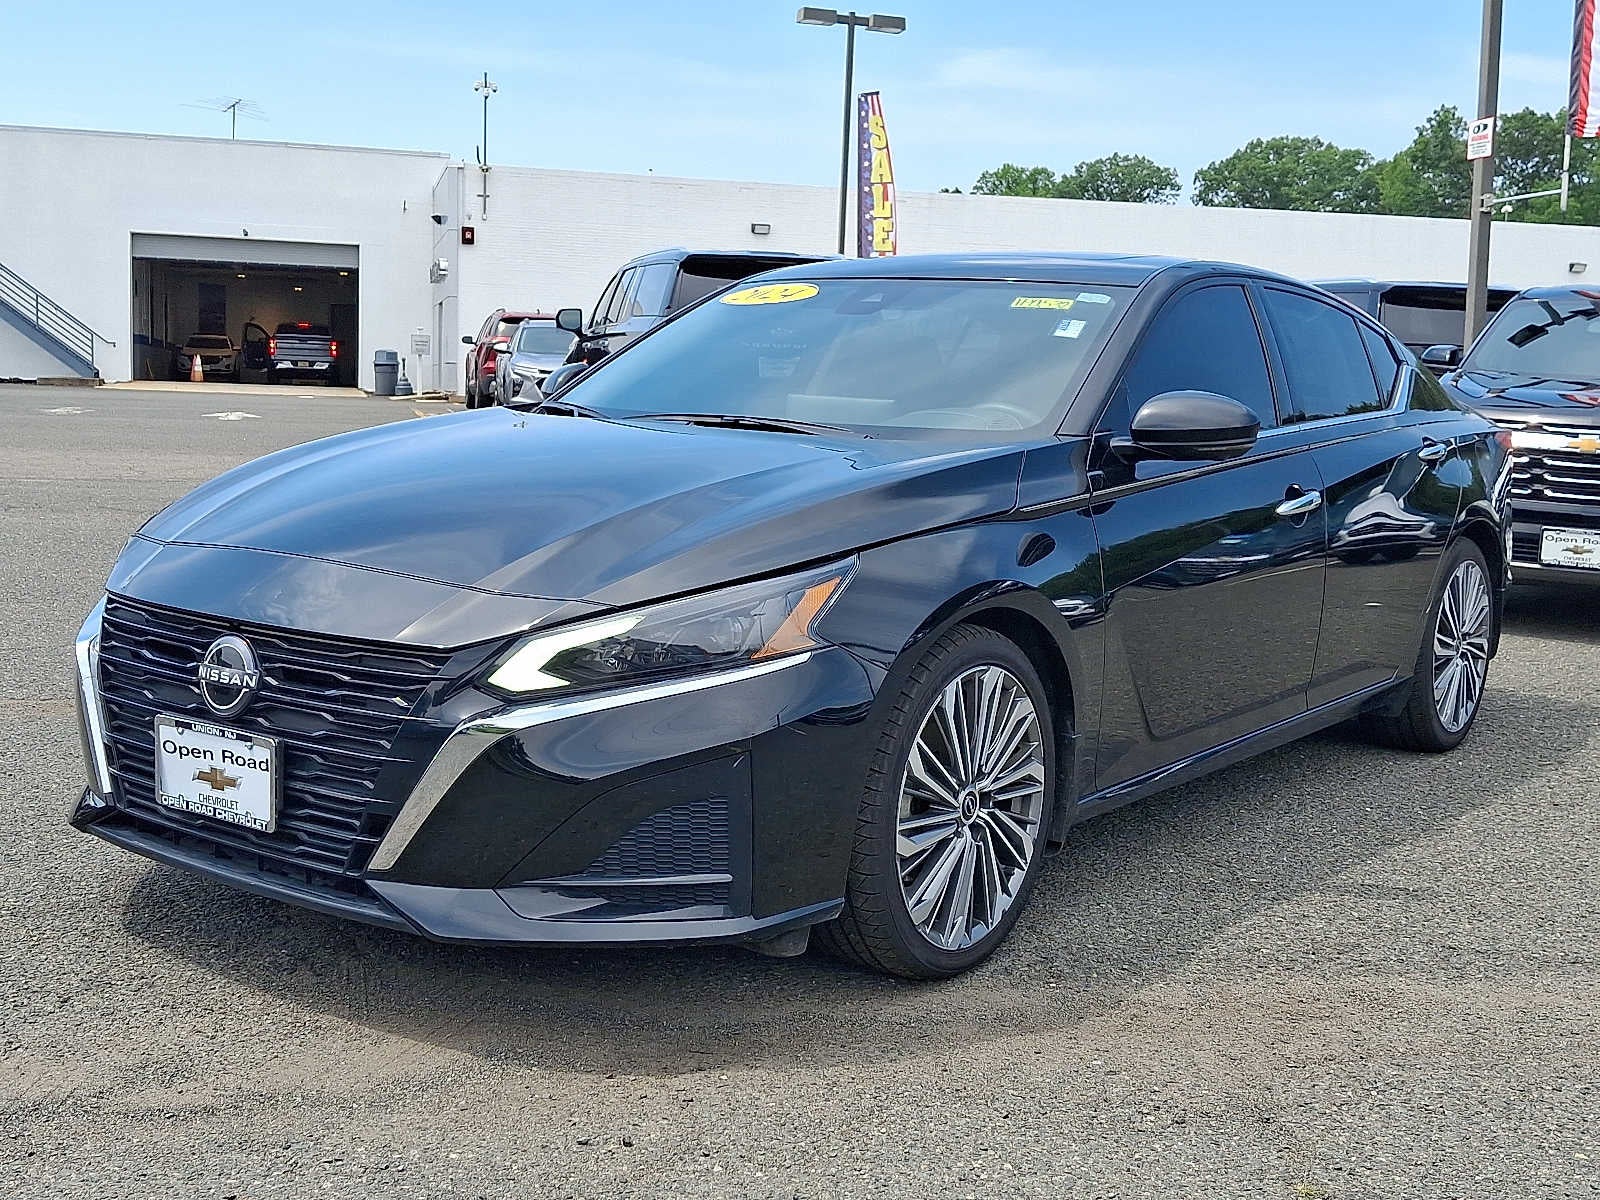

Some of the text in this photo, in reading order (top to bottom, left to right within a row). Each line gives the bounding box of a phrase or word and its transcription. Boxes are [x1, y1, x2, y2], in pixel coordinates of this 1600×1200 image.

[868, 115, 894, 252] SALE
[1582, 537, 1600, 545] Ro
[198, 665, 257, 687] NISSAN
[191, 723, 237, 739] UNION, NJ
[162, 740, 269, 772] Open Road
[198, 793, 239, 811] CHEVROLET
[161, 796, 267, 831] OPEN ROAD CHEVROLET
